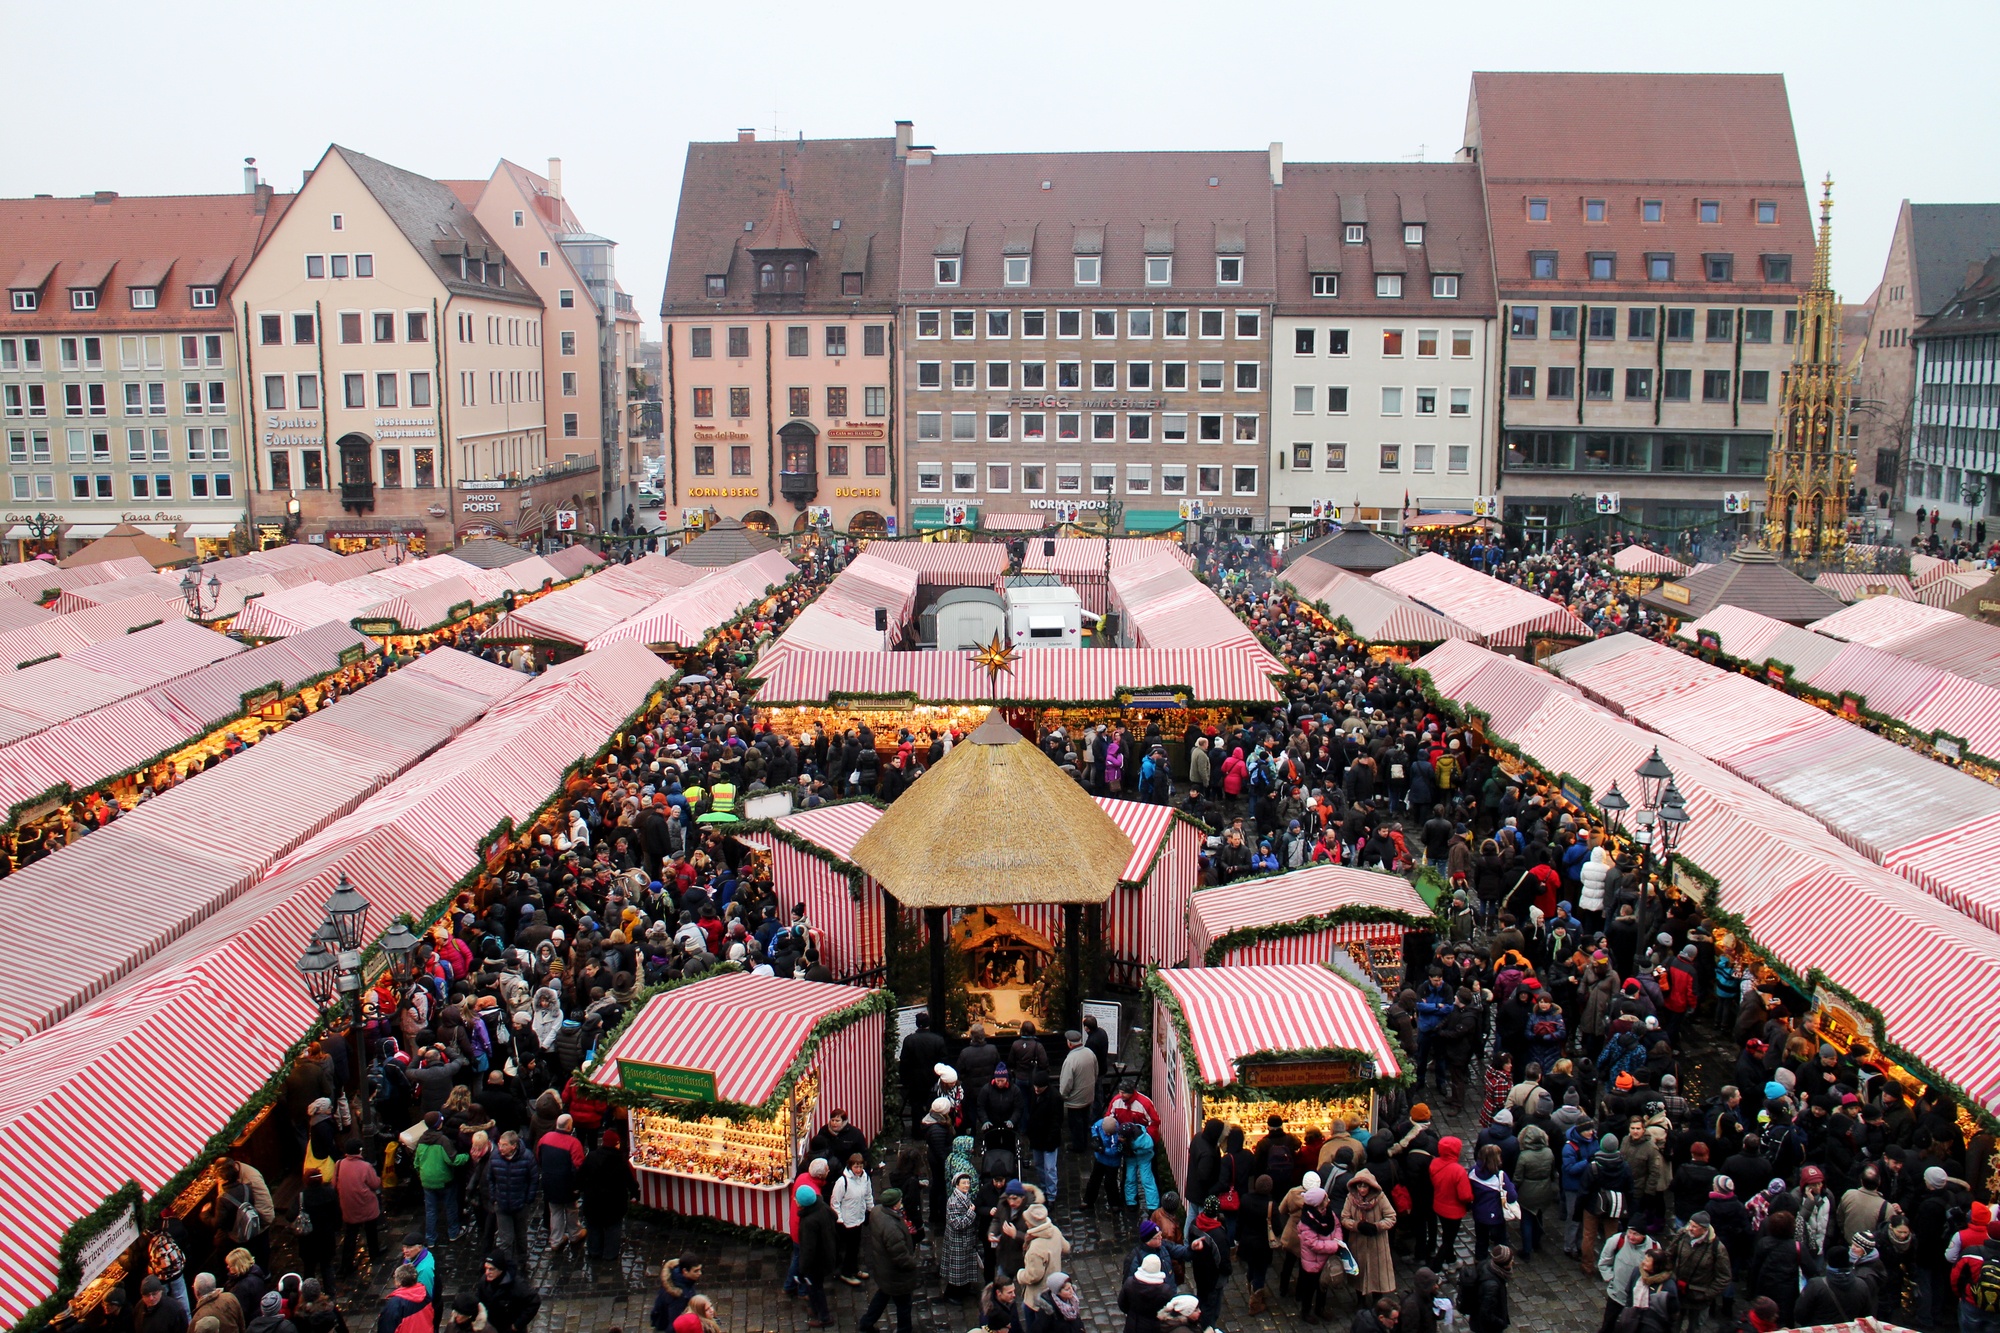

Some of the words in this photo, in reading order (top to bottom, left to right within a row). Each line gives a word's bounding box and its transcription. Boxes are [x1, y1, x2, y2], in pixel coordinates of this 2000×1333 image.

[267, 416, 318, 430] Spalter
[374, 416, 434, 427] Restaurant
[263, 432, 324, 446] Edelbiere
[374, 428, 436, 441] Hauptmarkt
[693, 431, 713, 440] Casa
[714, 431, 728, 440] del
[729, 431, 749, 440] Puro
[469, 481, 499, 489] Terrasse
[688, 487, 719, 497] KORN
[721, 487, 728, 497] &
[835, 486, 881, 497] BÜCHER
[466, 494, 496, 502] PHOTO
[463, 502, 501, 512] PORST
[5, 512, 33, 522] Casa
[124, 511, 152, 521] Casa
[154, 511, 183, 521] Pane
[678, 1087, 703, 1097] Nürnberg
